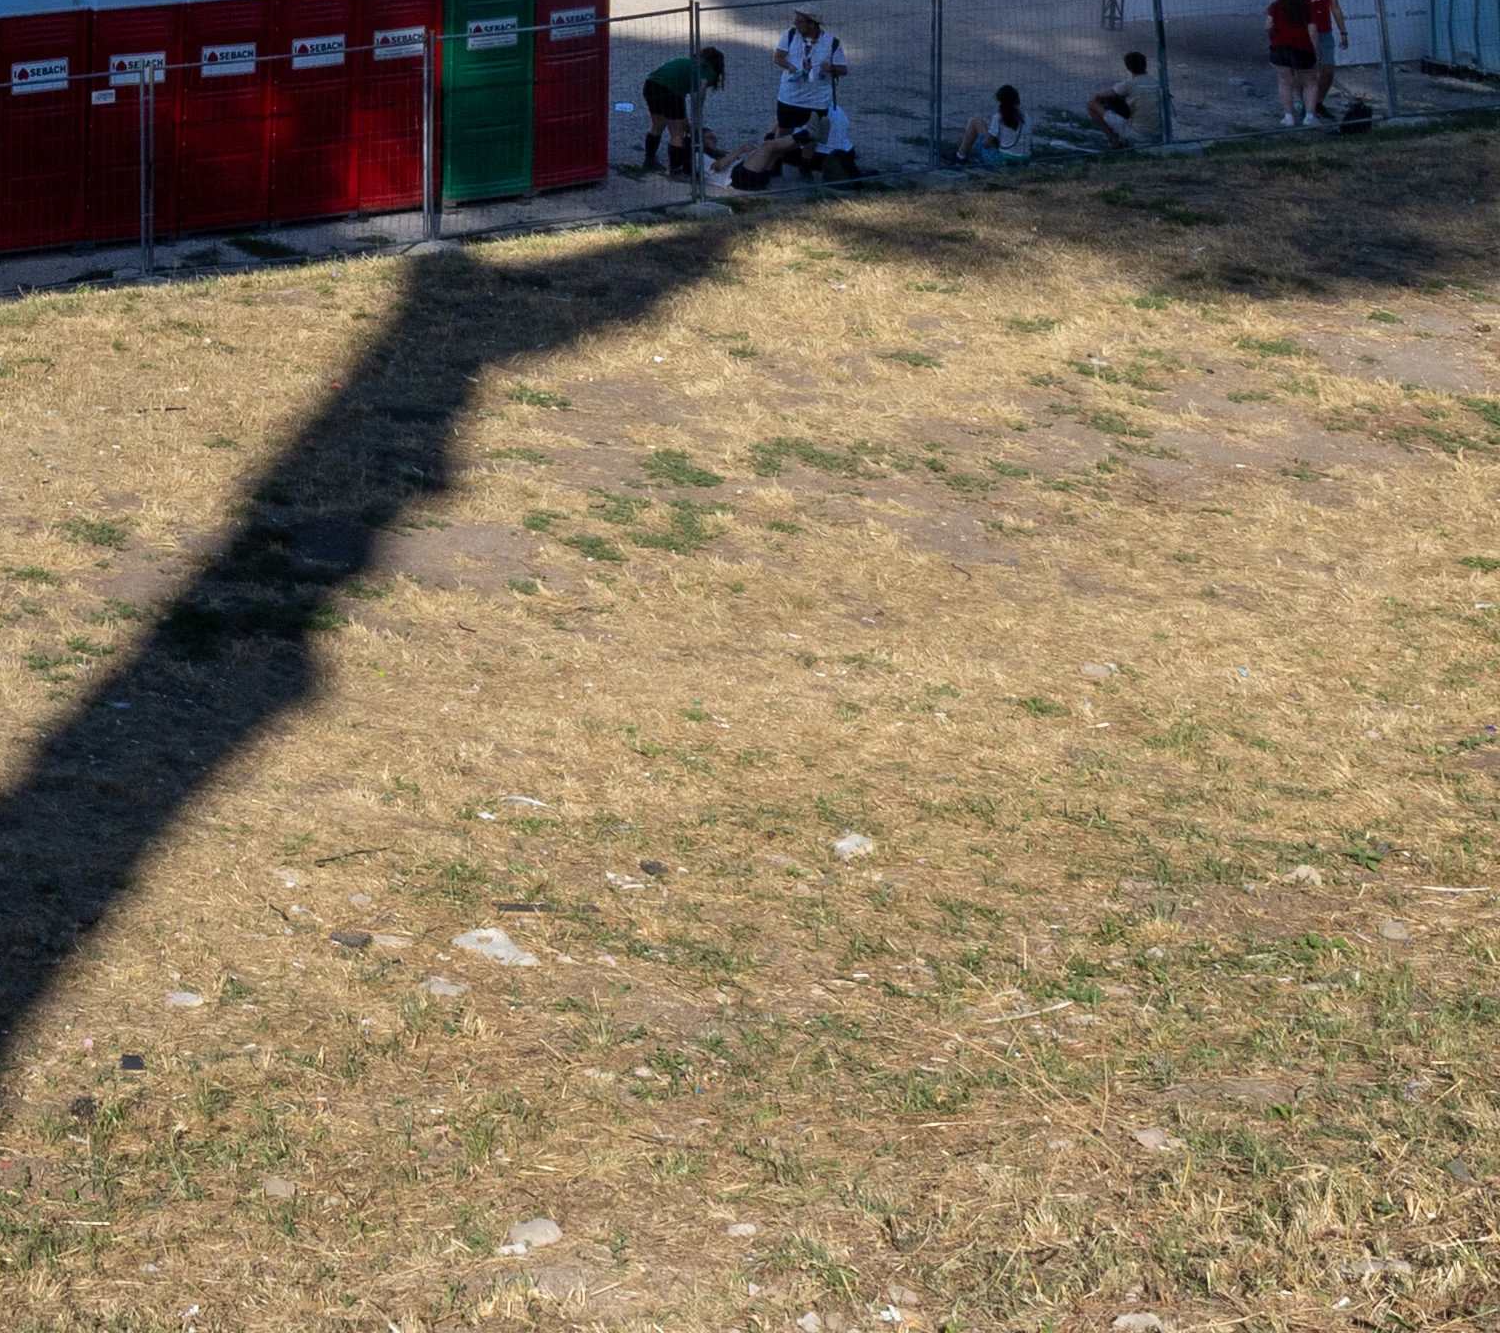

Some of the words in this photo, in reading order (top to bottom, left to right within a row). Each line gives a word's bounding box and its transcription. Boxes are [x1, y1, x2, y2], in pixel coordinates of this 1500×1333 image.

[390, 34, 422, 44] SEBACH
[310, 42, 343, 53] SEBACH
[219, 50, 254, 60] SEBACH
[30, 65, 66, 78] SEBACH
